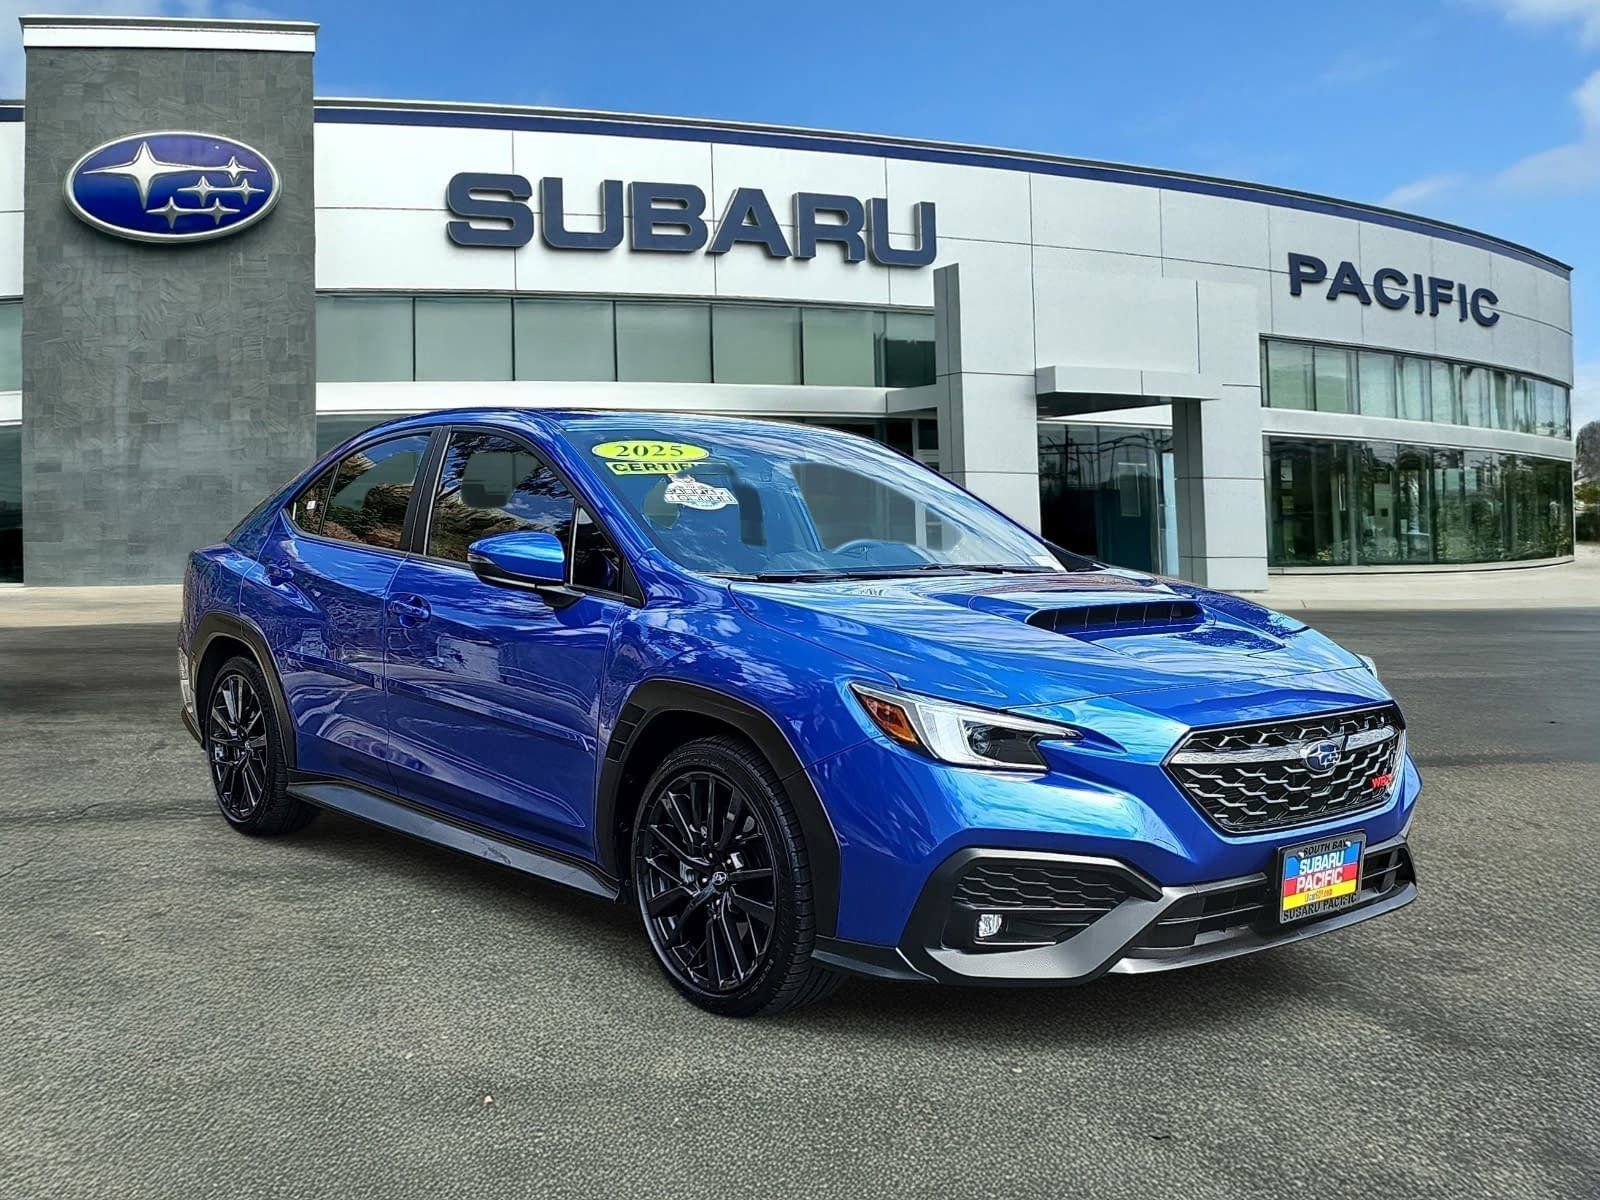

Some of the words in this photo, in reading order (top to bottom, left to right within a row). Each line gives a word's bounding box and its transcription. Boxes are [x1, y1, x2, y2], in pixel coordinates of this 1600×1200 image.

[446, 172, 937, 267] SUBARU
[1288, 252, 1500, 327] PACIFIC
[615, 445, 684, 457] 2025
[612, 463, 696, 472] CERTIF
[1303, 842, 1331, 855] SOUTH
[1299, 850, 1345, 875] SUBARU
[1296, 867, 1344, 893] PACIFIC
[1283, 904, 1320, 921] SUBARU
[1323, 894, 1357, 911] PACIFIC
